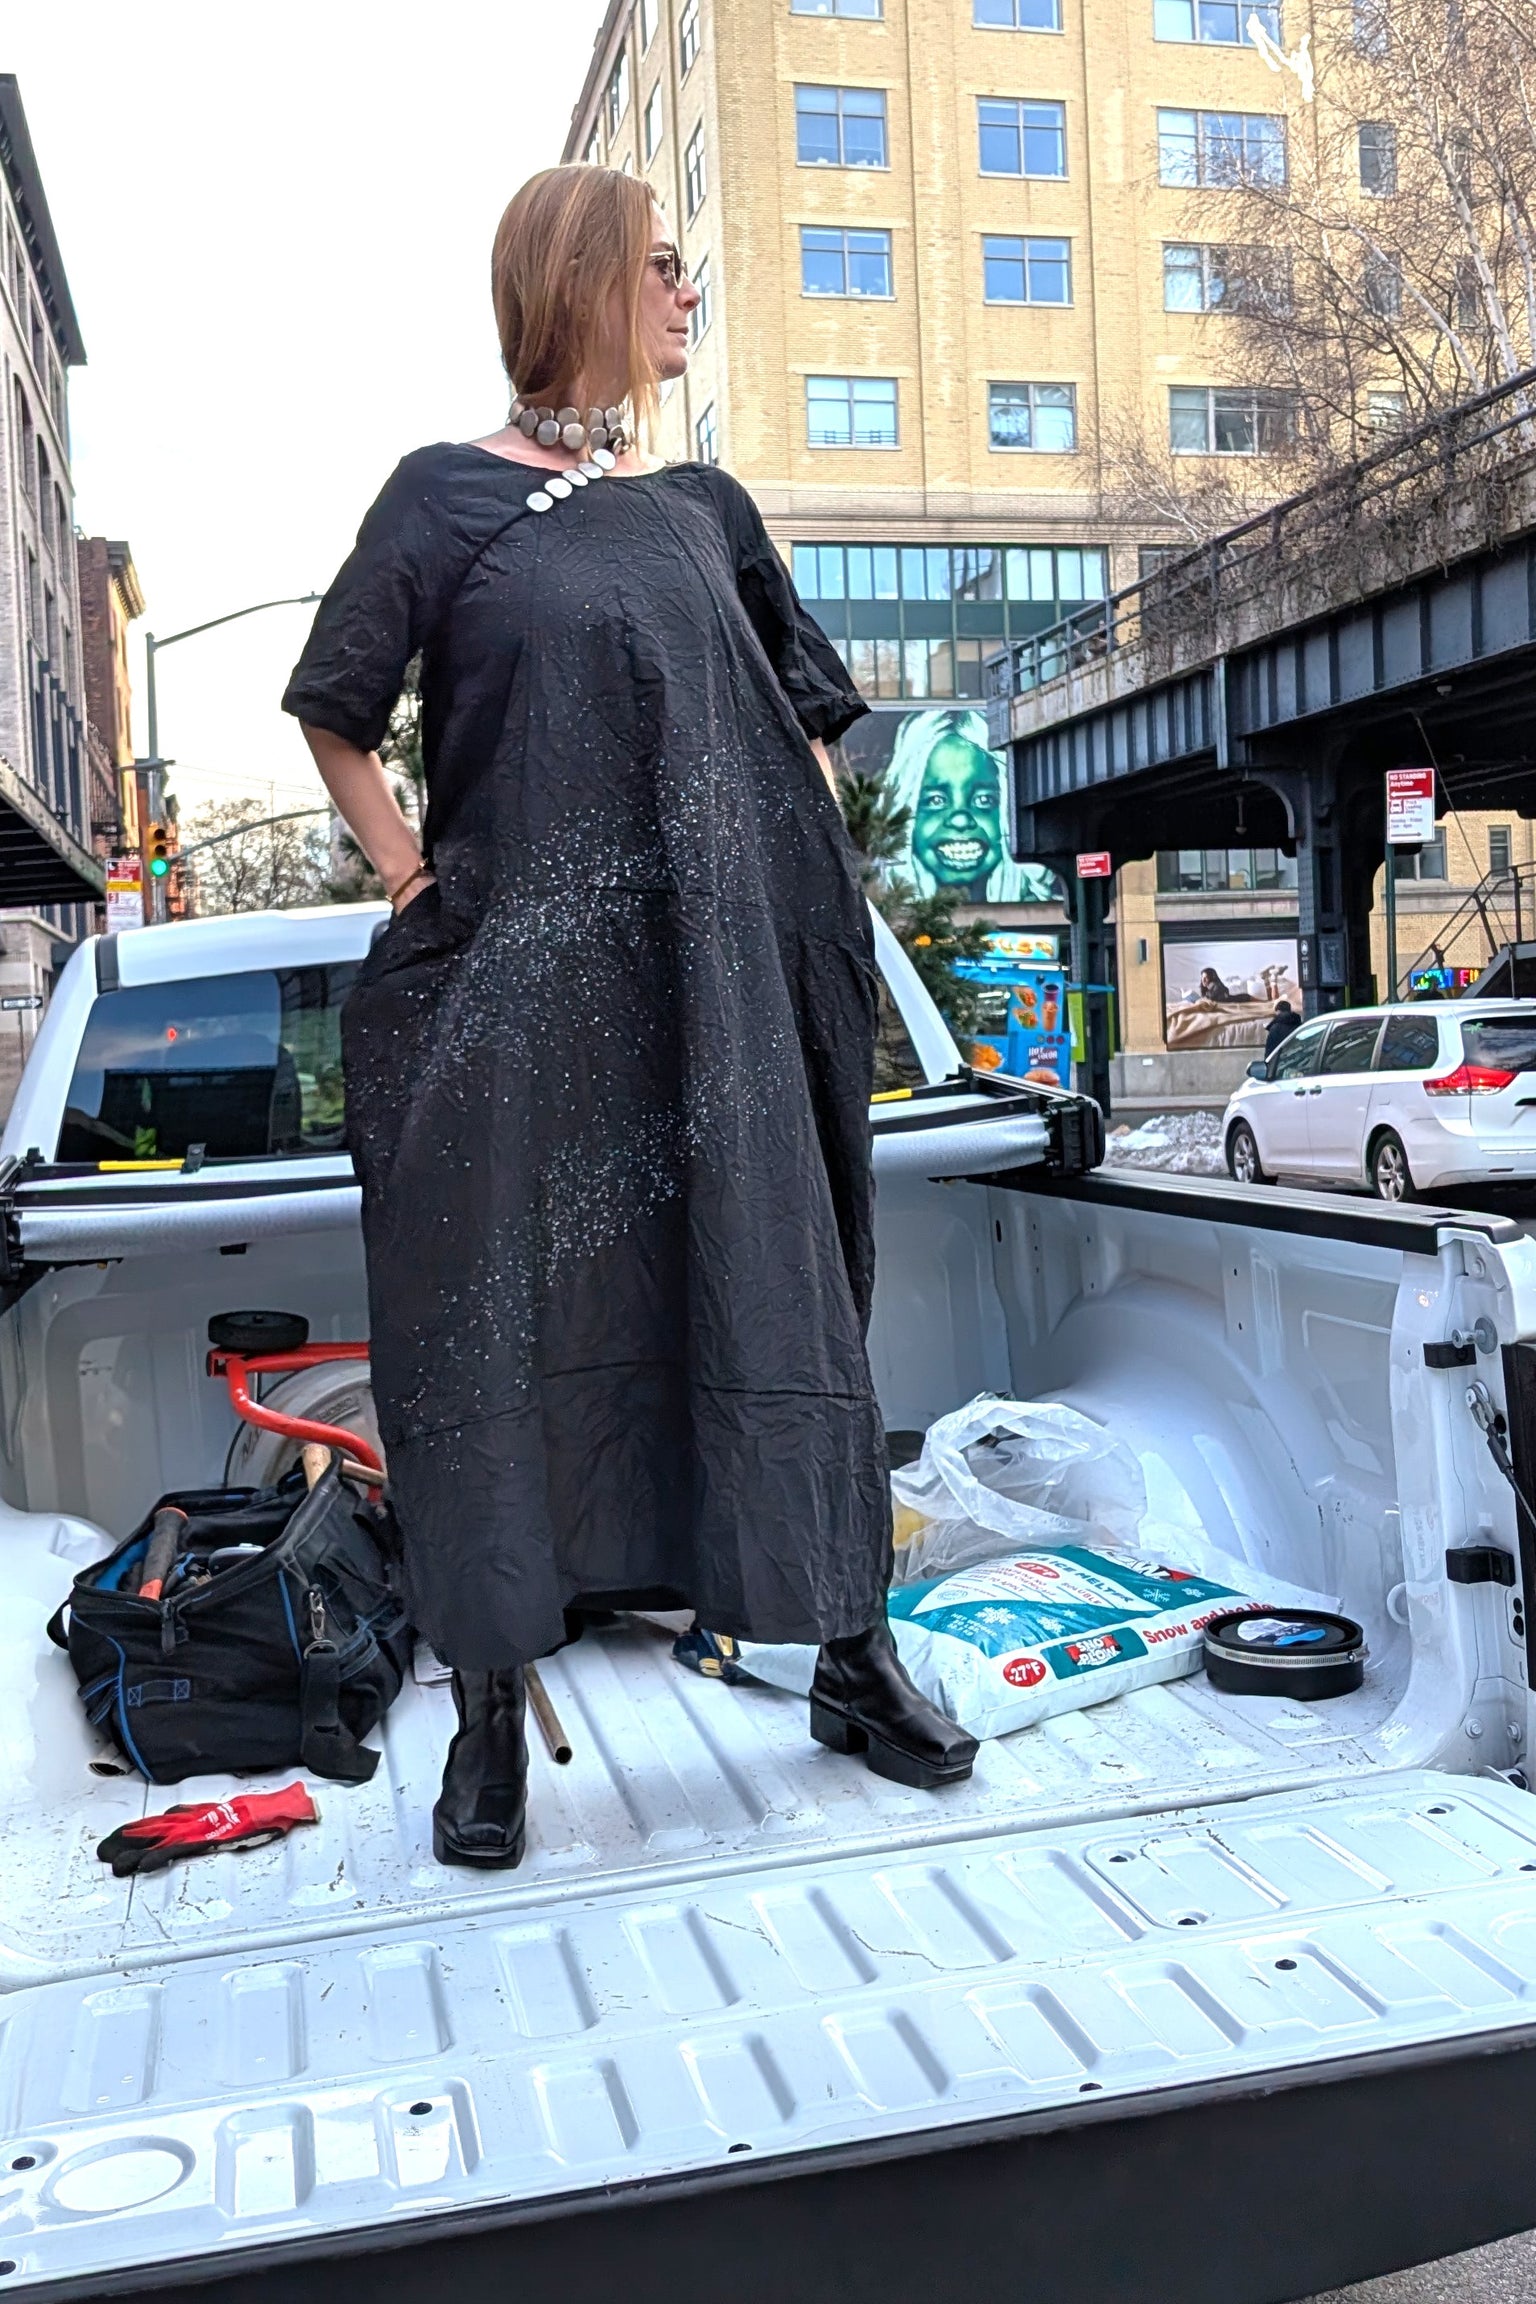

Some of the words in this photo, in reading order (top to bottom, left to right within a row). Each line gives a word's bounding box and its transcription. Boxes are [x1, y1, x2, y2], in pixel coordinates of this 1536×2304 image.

[1399, 772, 1427, 780] STANDING
[1048, 1560, 1077, 1573] ICE
[1142, 1621, 1188, 1644] Snow
[1190, 1610, 1219, 1631] and
[1075, 1638, 1105, 1652] SNO
[1078, 1645, 1117, 1663] PLOW
